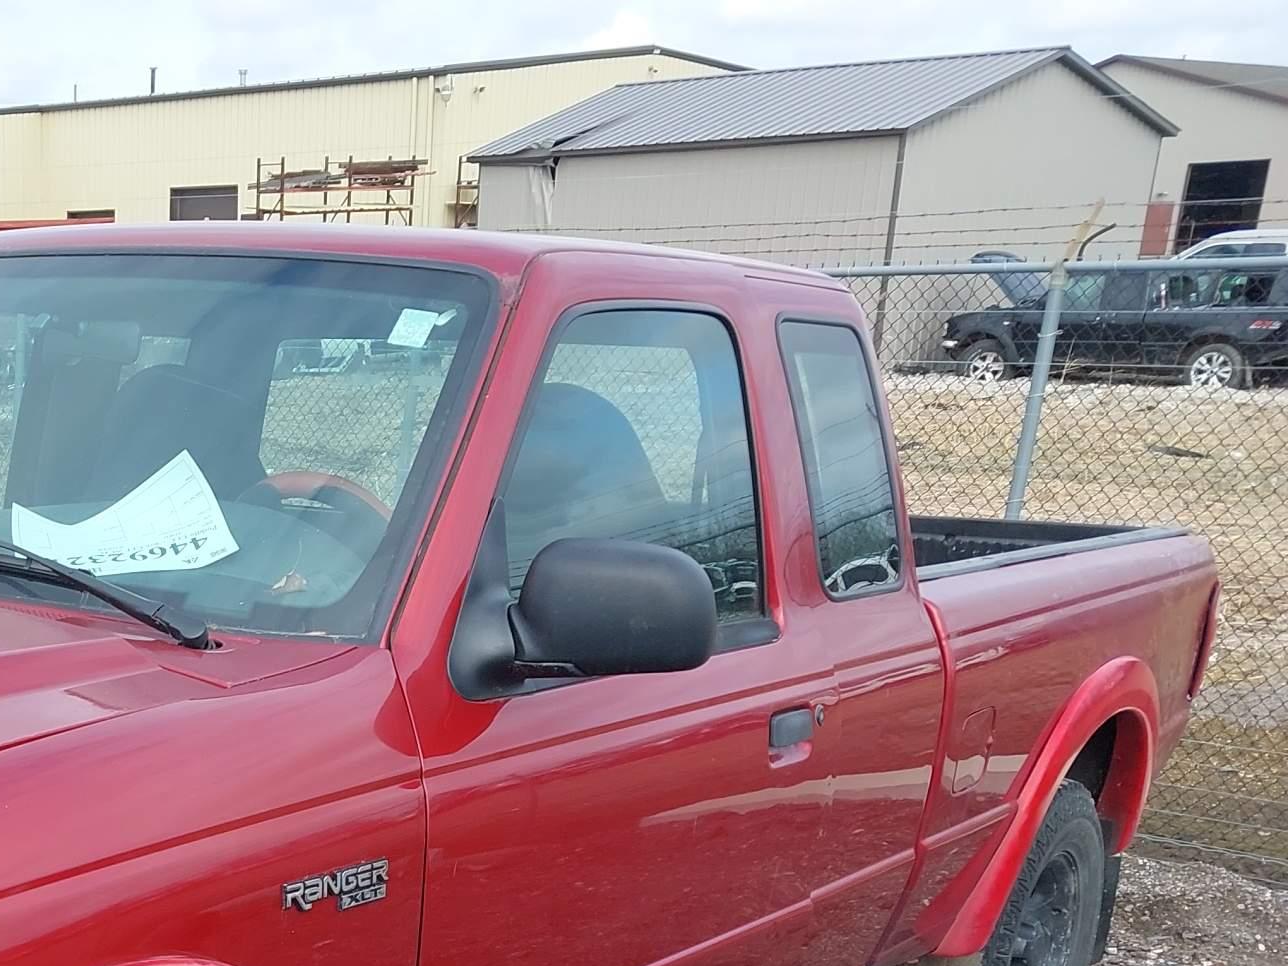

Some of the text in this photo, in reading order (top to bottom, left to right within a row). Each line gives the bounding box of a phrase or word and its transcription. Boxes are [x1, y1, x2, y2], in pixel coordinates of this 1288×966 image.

[68, 536, 209, 567] 4469232
[283, 858, 390, 911] RANGER
[344, 886, 385, 907] XLT
